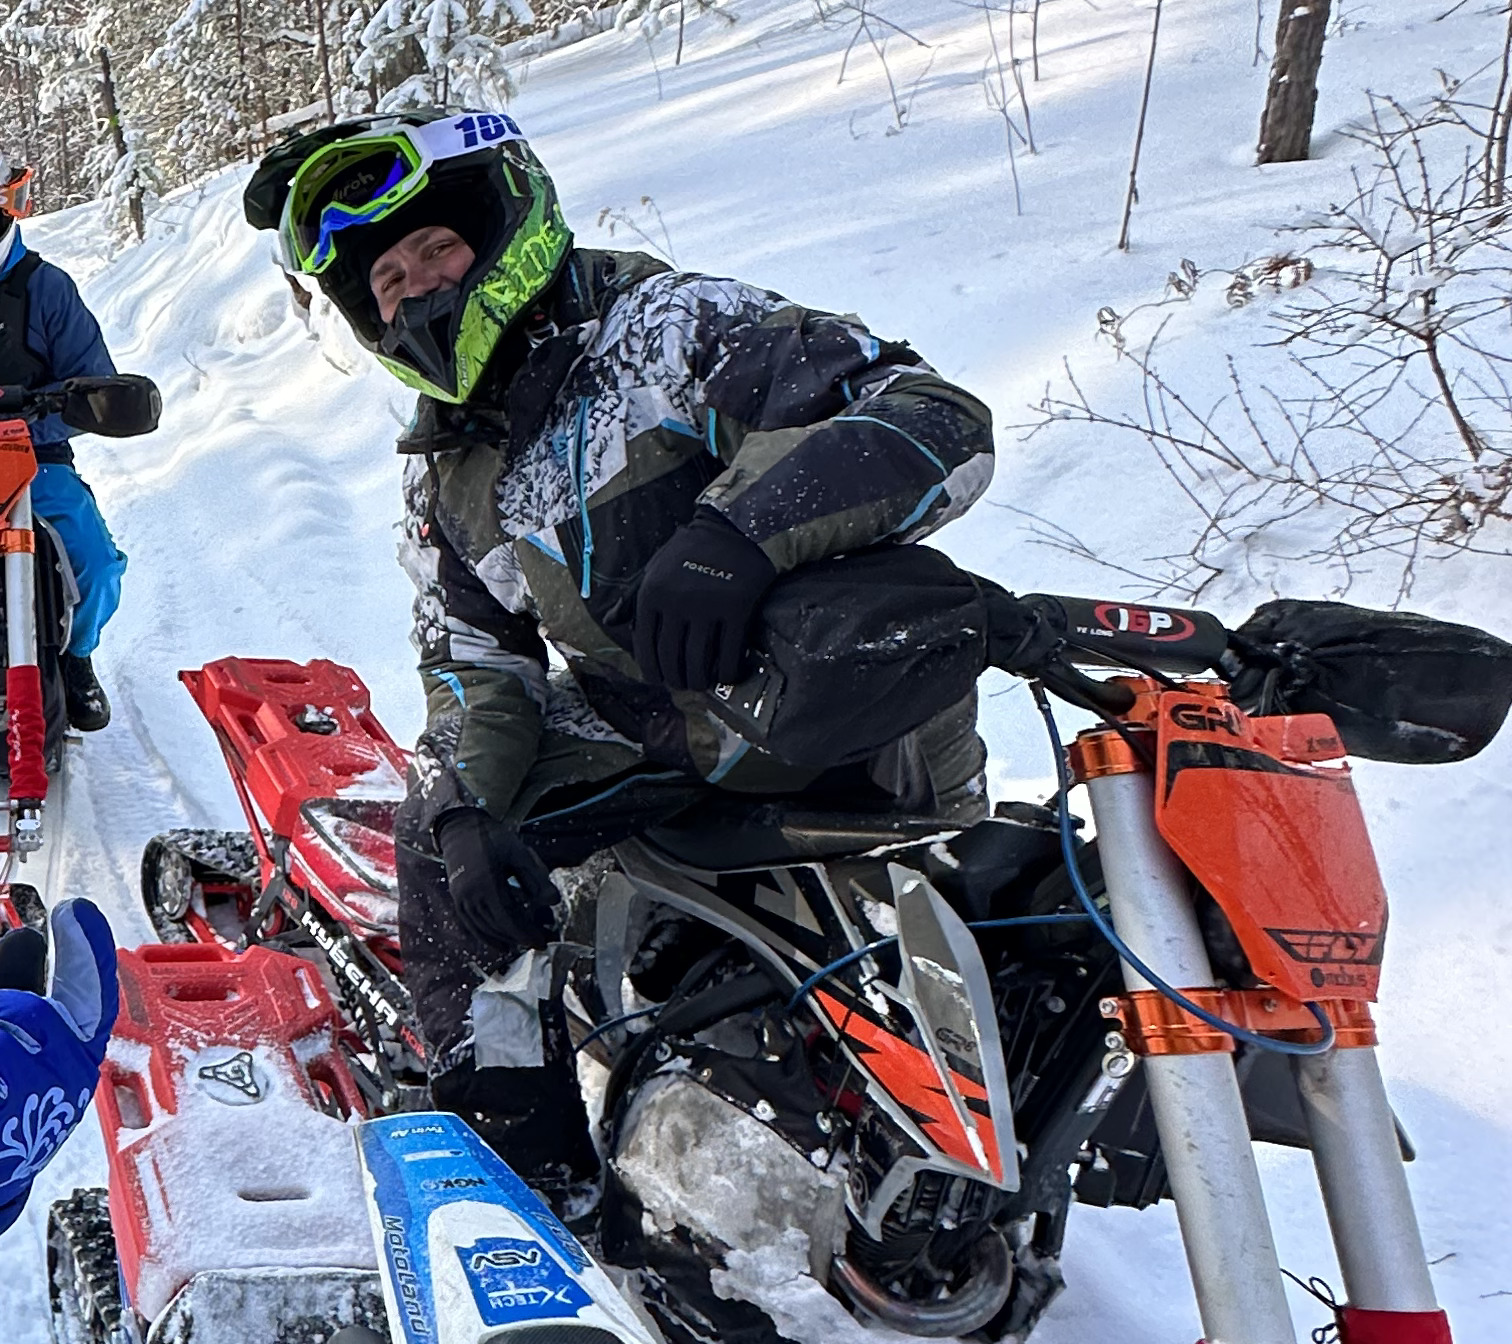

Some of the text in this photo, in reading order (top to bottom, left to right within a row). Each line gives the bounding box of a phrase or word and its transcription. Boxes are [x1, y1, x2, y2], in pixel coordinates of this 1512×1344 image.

[683, 561, 734, 581] FORCLAZ
[1117, 607, 1173, 635] IGP
[440, 1177, 488, 1189] NGK
